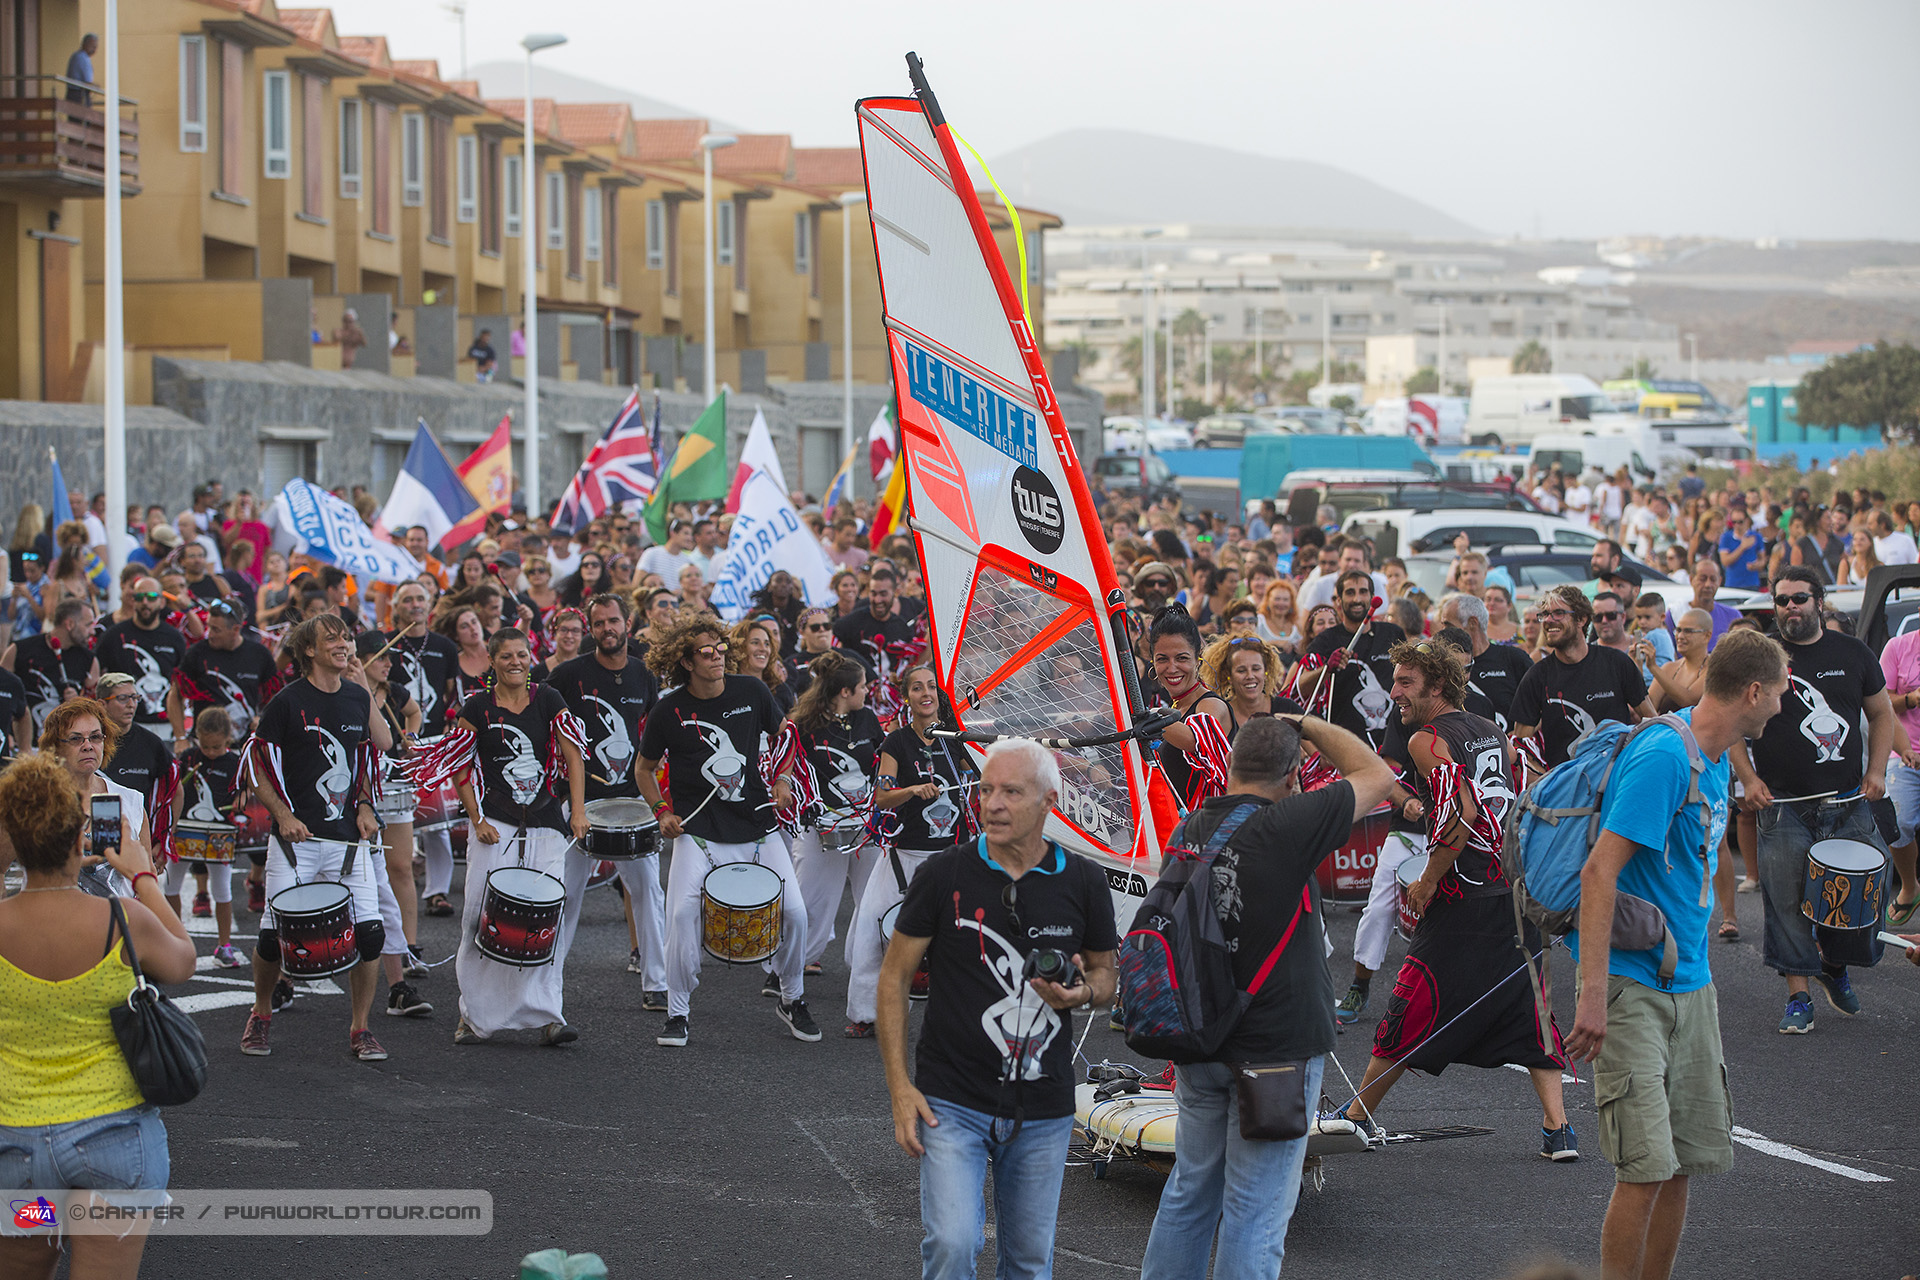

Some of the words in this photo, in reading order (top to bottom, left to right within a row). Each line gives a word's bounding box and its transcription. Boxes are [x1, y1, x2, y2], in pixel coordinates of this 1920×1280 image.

[909, 345, 1035, 453] TENERIFE
[978, 422, 991, 443] EL
[994, 431, 1036, 469] MÉDANO
[1014, 479, 1061, 528] tws
[731, 507, 799, 582] WORLD
[1104, 868, 1145, 894] .com
